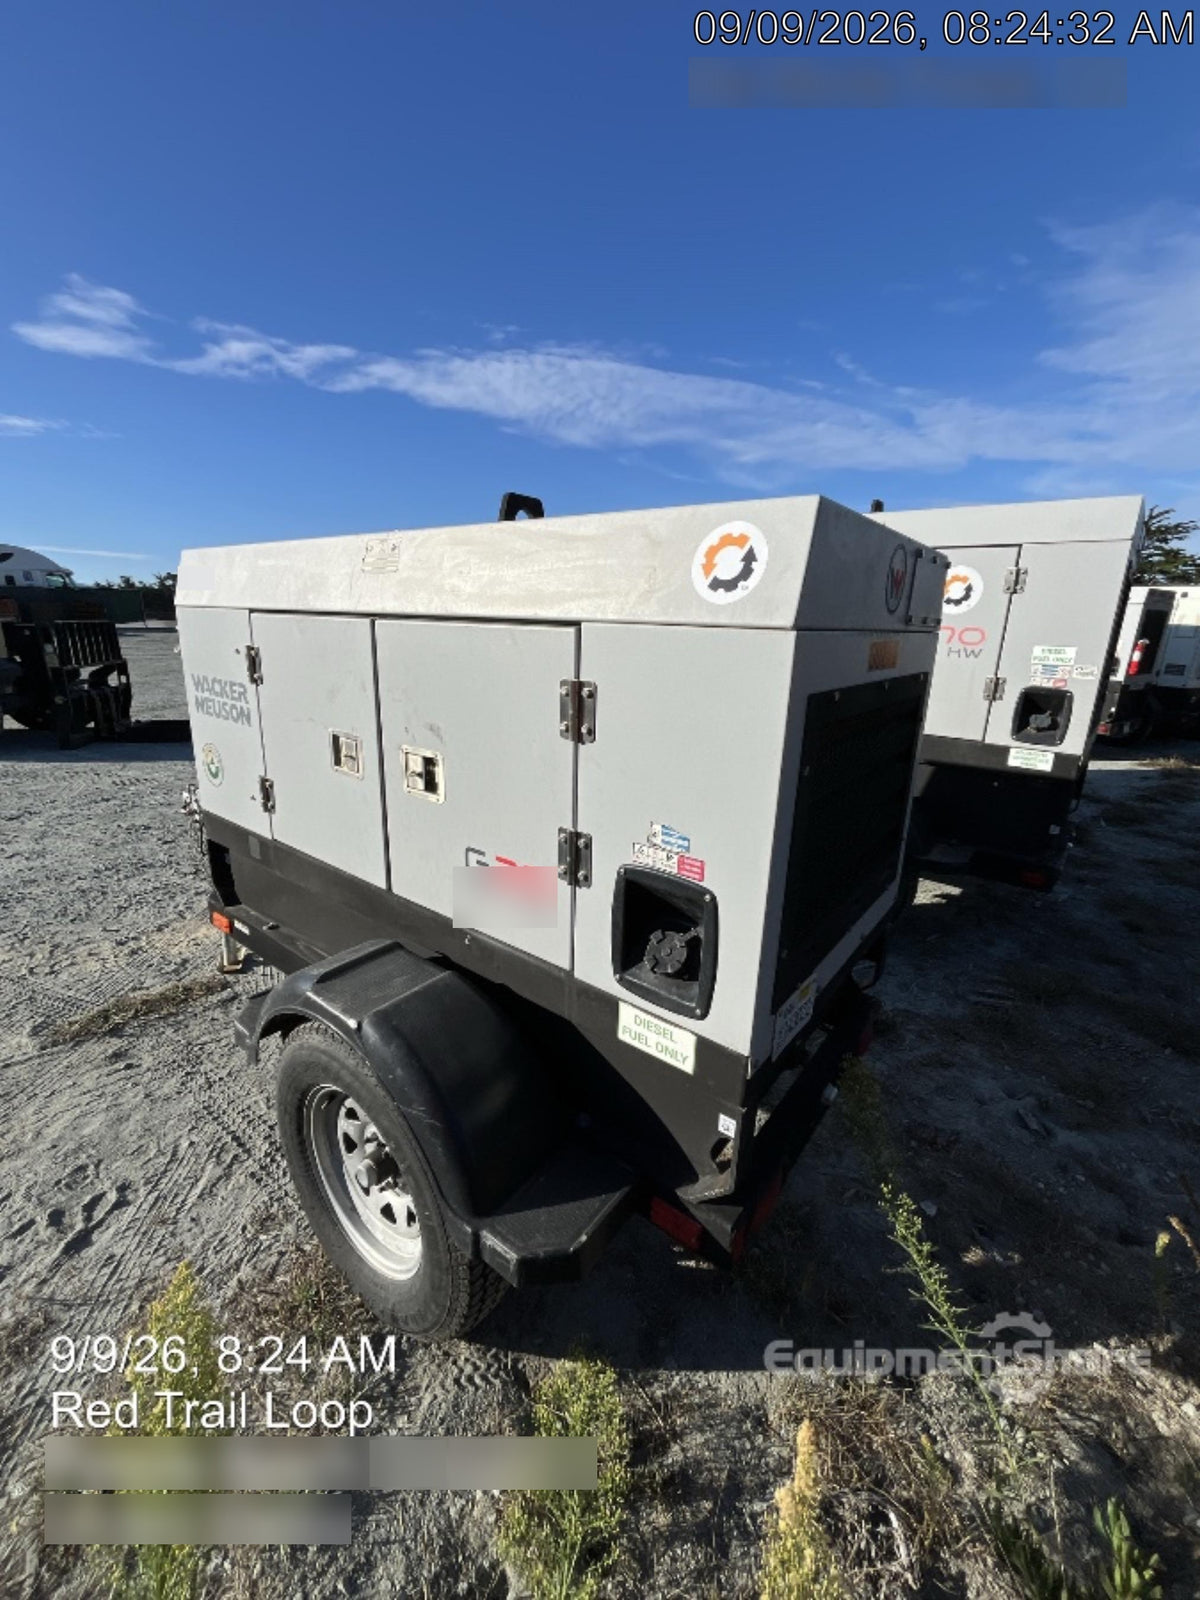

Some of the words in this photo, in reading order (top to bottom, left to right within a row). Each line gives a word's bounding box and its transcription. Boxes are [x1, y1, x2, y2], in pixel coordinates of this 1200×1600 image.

[191, 673, 249, 704] WACKER
[195, 694, 252, 727] NEUSON
[634, 1014, 677, 1043] DIESEL
[622, 1025, 651, 1048] FUEL
[655, 1041, 689, 1065] ONLY
